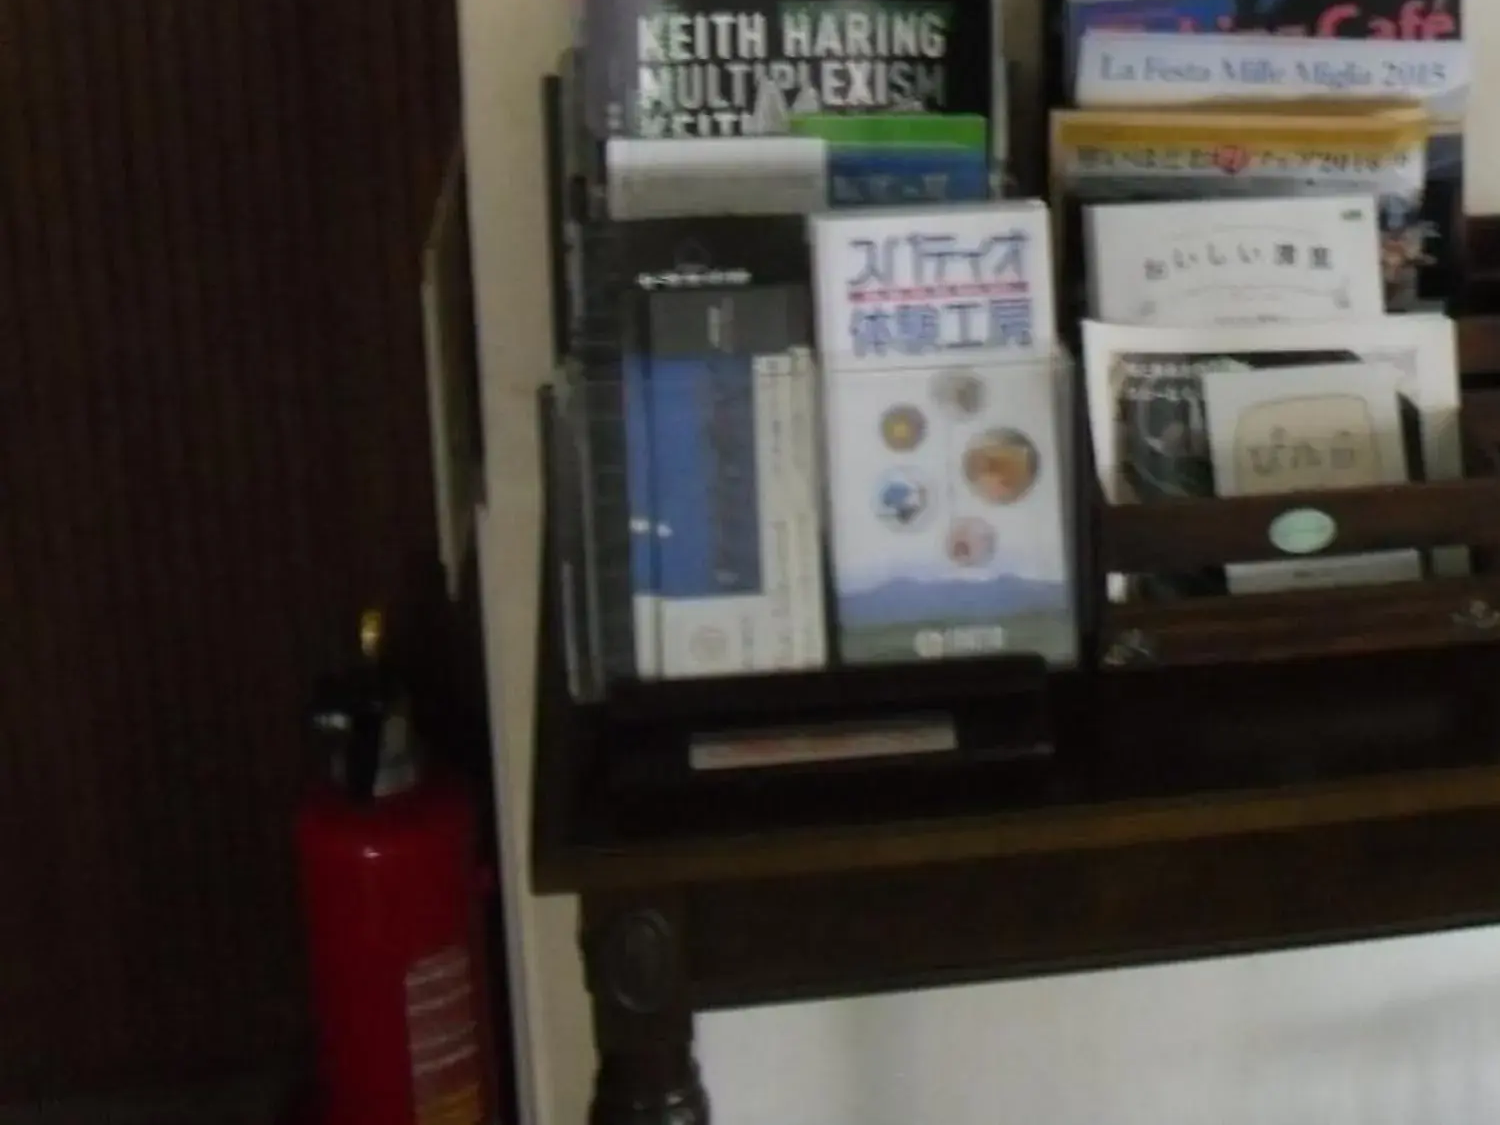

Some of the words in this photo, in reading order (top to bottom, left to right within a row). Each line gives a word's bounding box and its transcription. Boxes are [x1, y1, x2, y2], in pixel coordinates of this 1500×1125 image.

[637, 11, 768, 62] KEITH
[782, 9, 948, 60] HARING
[1101, 53, 1137, 83] La
[1144, 55, 1213, 85] Festa
[1221, 57, 1288, 86] Mille
[1295, 58, 1373, 91] Miglia
[847, 298, 1034, 359] 体験工房
